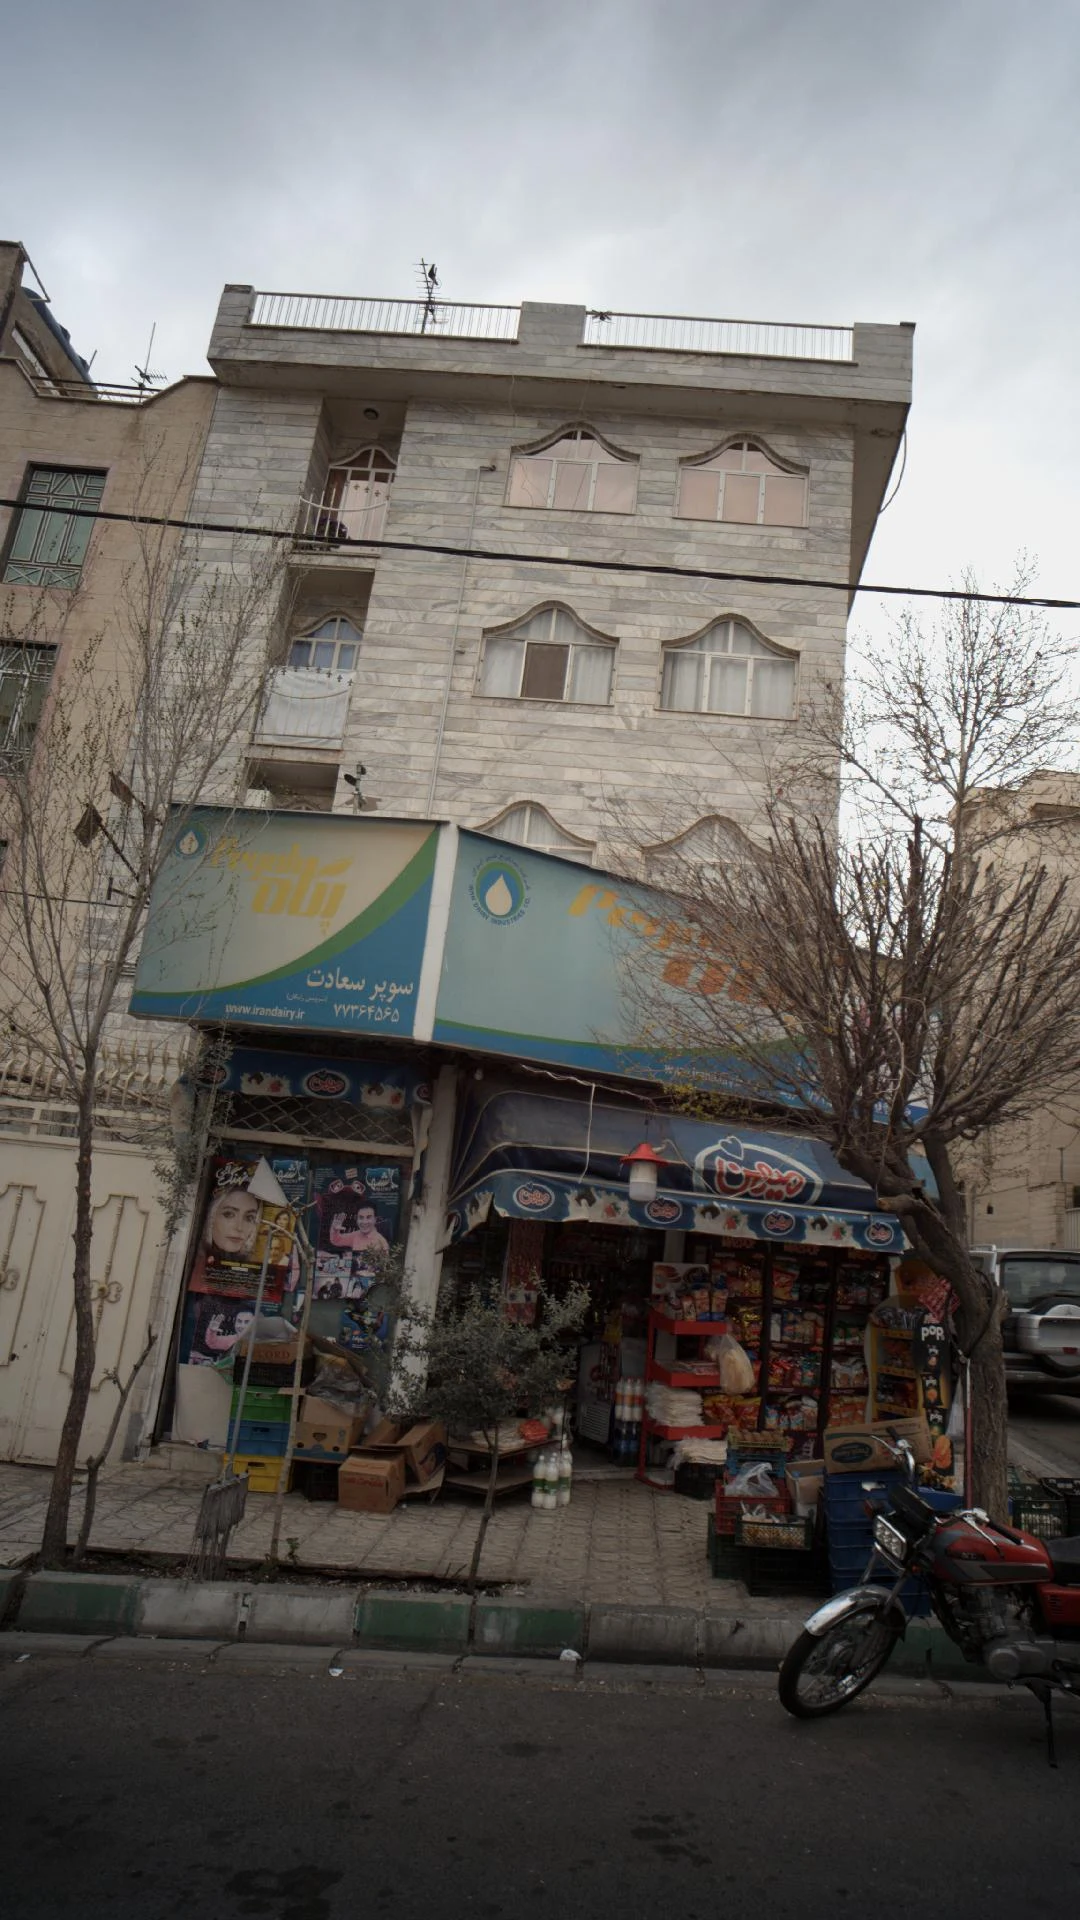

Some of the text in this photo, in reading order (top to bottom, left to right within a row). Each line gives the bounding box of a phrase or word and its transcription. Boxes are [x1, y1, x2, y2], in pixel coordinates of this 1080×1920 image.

[306, 966, 414, 1003] سوپر سعادت
[225, 1003, 305, 1021] www.irandairy.ir
[715, 1156, 807, 1201] میهن
